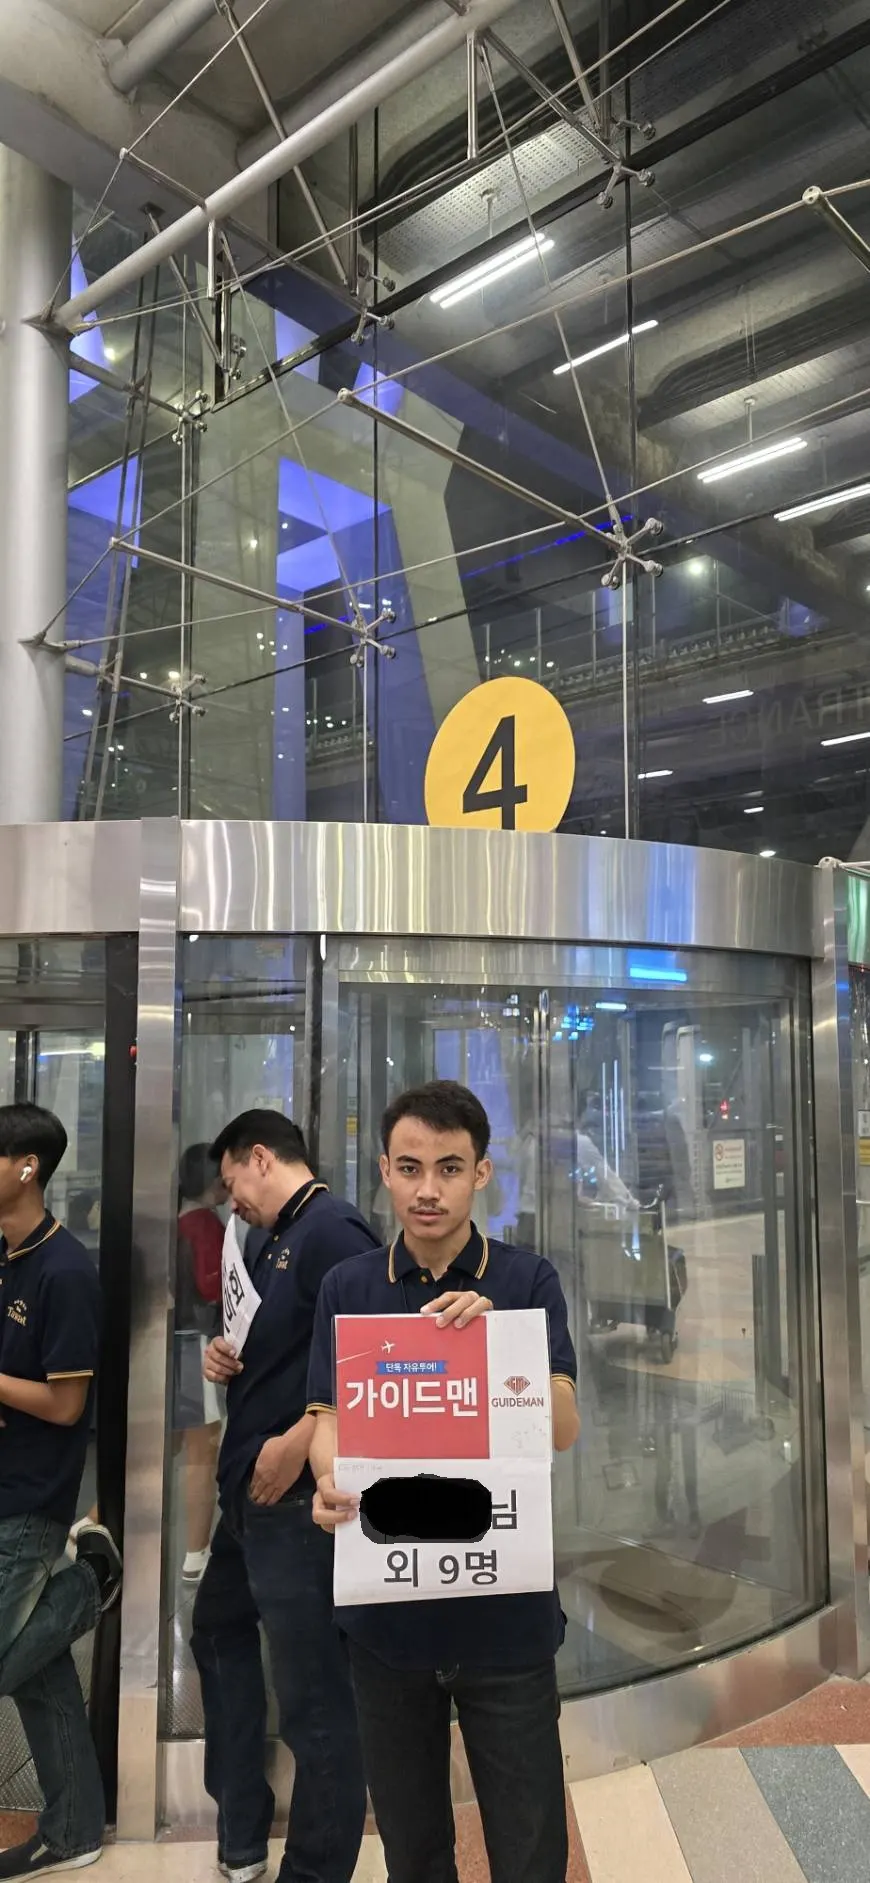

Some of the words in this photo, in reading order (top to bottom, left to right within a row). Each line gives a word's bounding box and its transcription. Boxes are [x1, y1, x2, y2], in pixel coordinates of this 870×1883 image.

[462, 714, 528, 831] 4
[385, 1362, 402, 1374] 단독
[346, 1377, 478, 1418] 가이드맨
[491, 1396, 544, 1408] GUIDEMAN
[384, 1548, 418, 1588] 외
